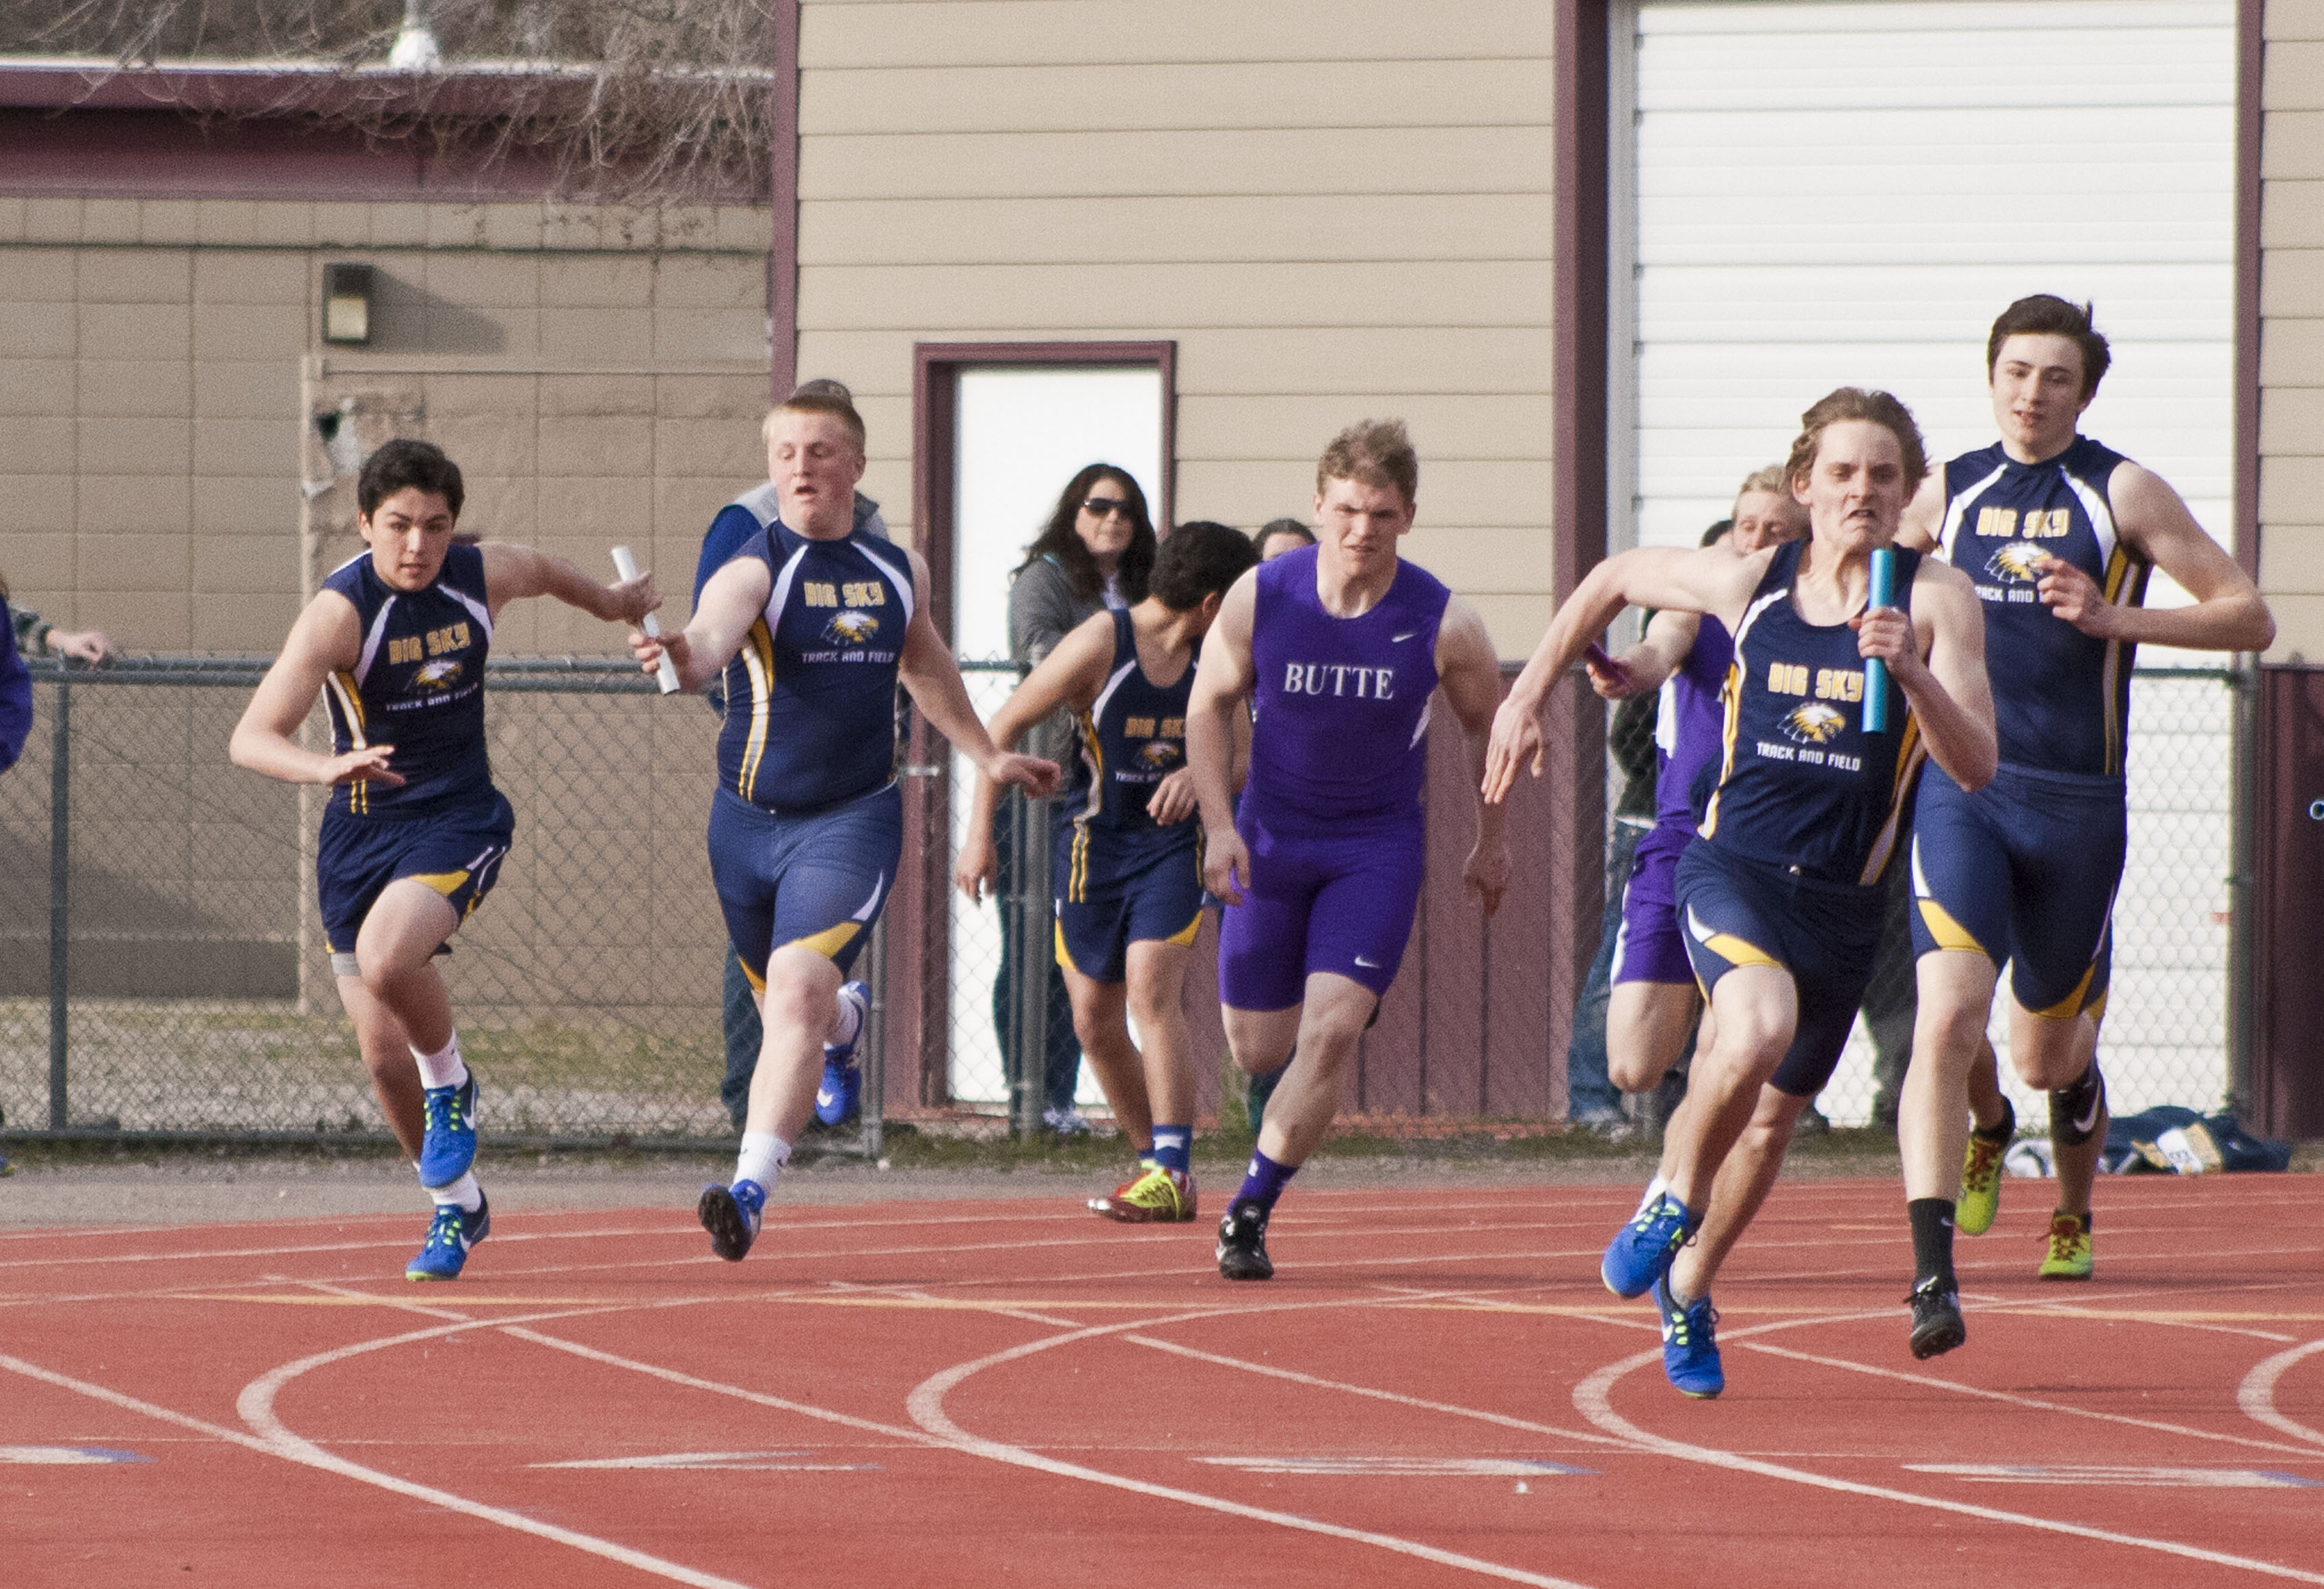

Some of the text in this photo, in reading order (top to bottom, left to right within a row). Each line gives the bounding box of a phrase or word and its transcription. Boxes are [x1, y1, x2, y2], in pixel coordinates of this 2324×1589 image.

[1975, 507, 2070, 539] BIG SKY
[804, 582, 884, 607] BIG SKY
[2008, 588, 2035, 603] AND
[389, 621, 471, 665] BIG SKY
[802, 651, 894, 663] TRACK AND FIELD
[1283, 662, 1394, 700] BUTTE
[1768, 662, 1865, 702] BIG SKY
[1124, 718, 1186, 737] BIG SK
[1757, 742, 1861, 772] TRACK AND FIELD
